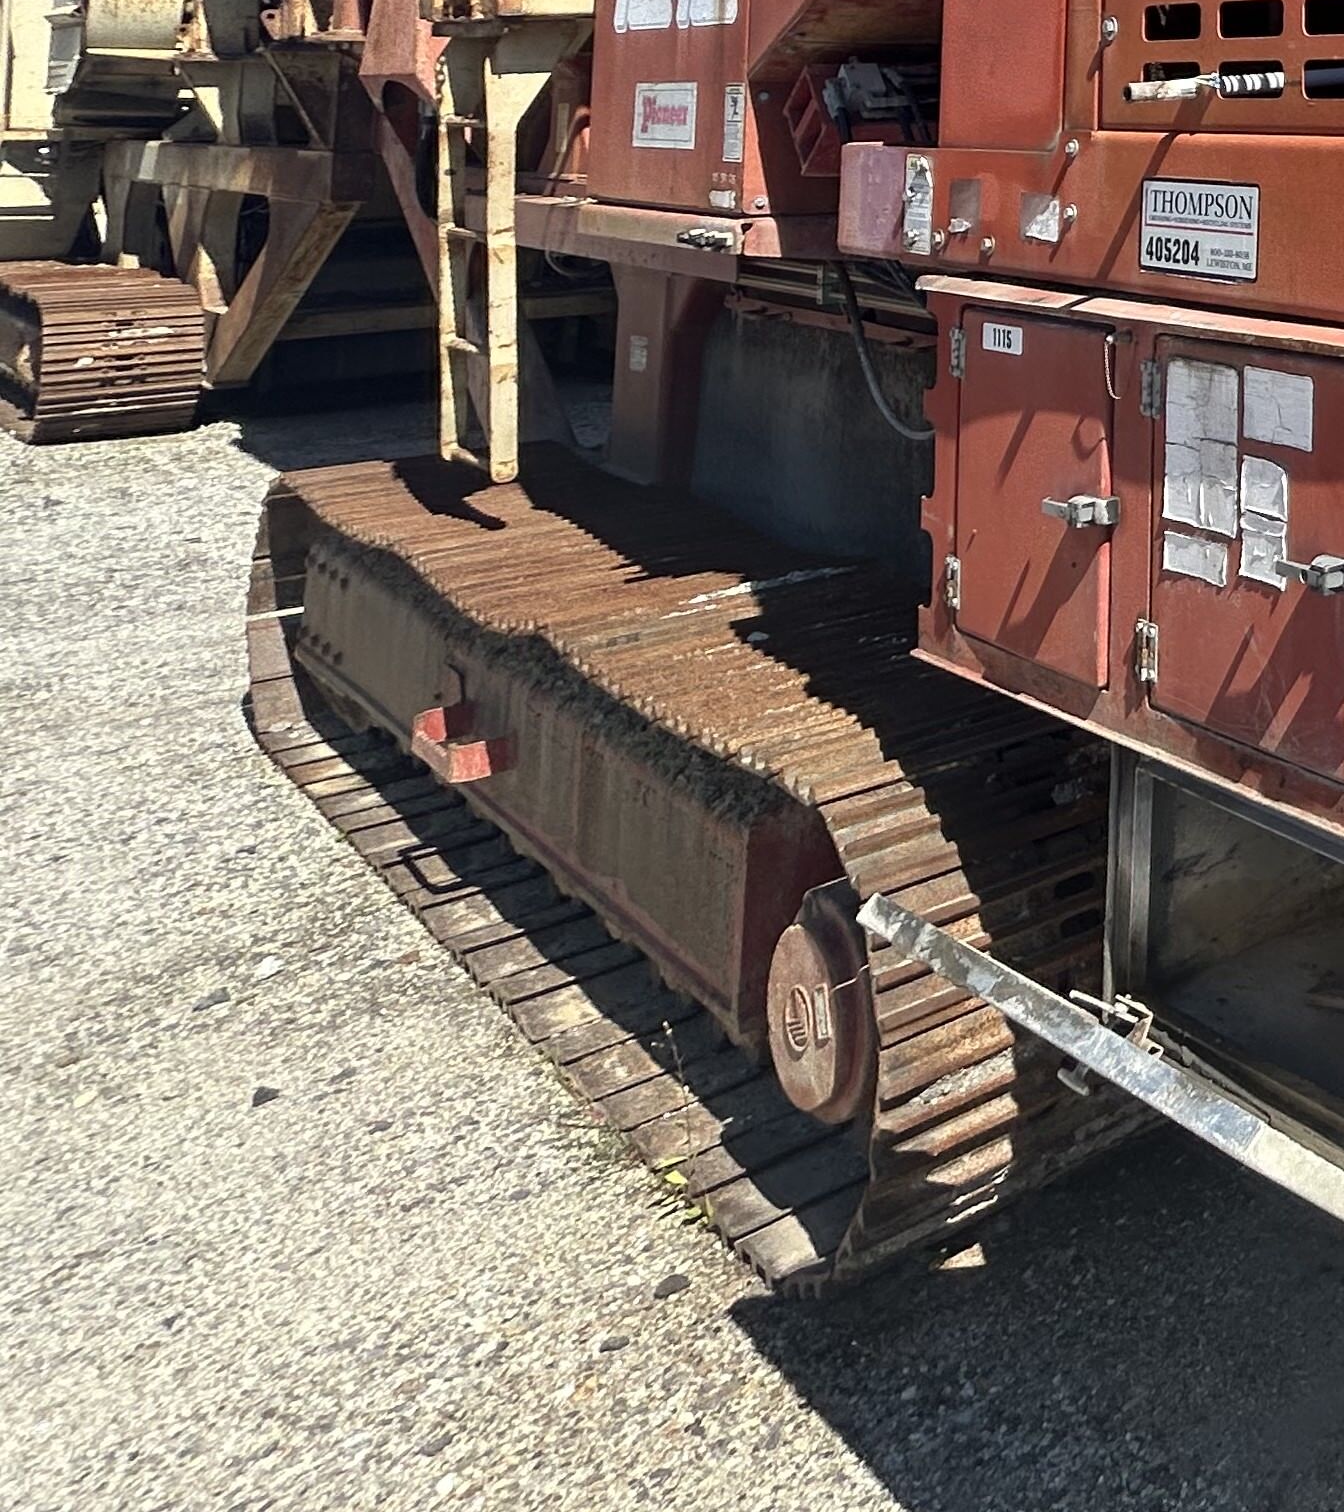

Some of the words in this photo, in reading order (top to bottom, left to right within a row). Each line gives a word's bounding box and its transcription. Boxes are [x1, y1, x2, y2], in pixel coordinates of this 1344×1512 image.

[641, 94, 689, 134] Pioneer
[1151, 189, 1254, 220] THOMPSON
[1145, 235, 1200, 266] 405204
[992, 327, 1012, 350] 1115
